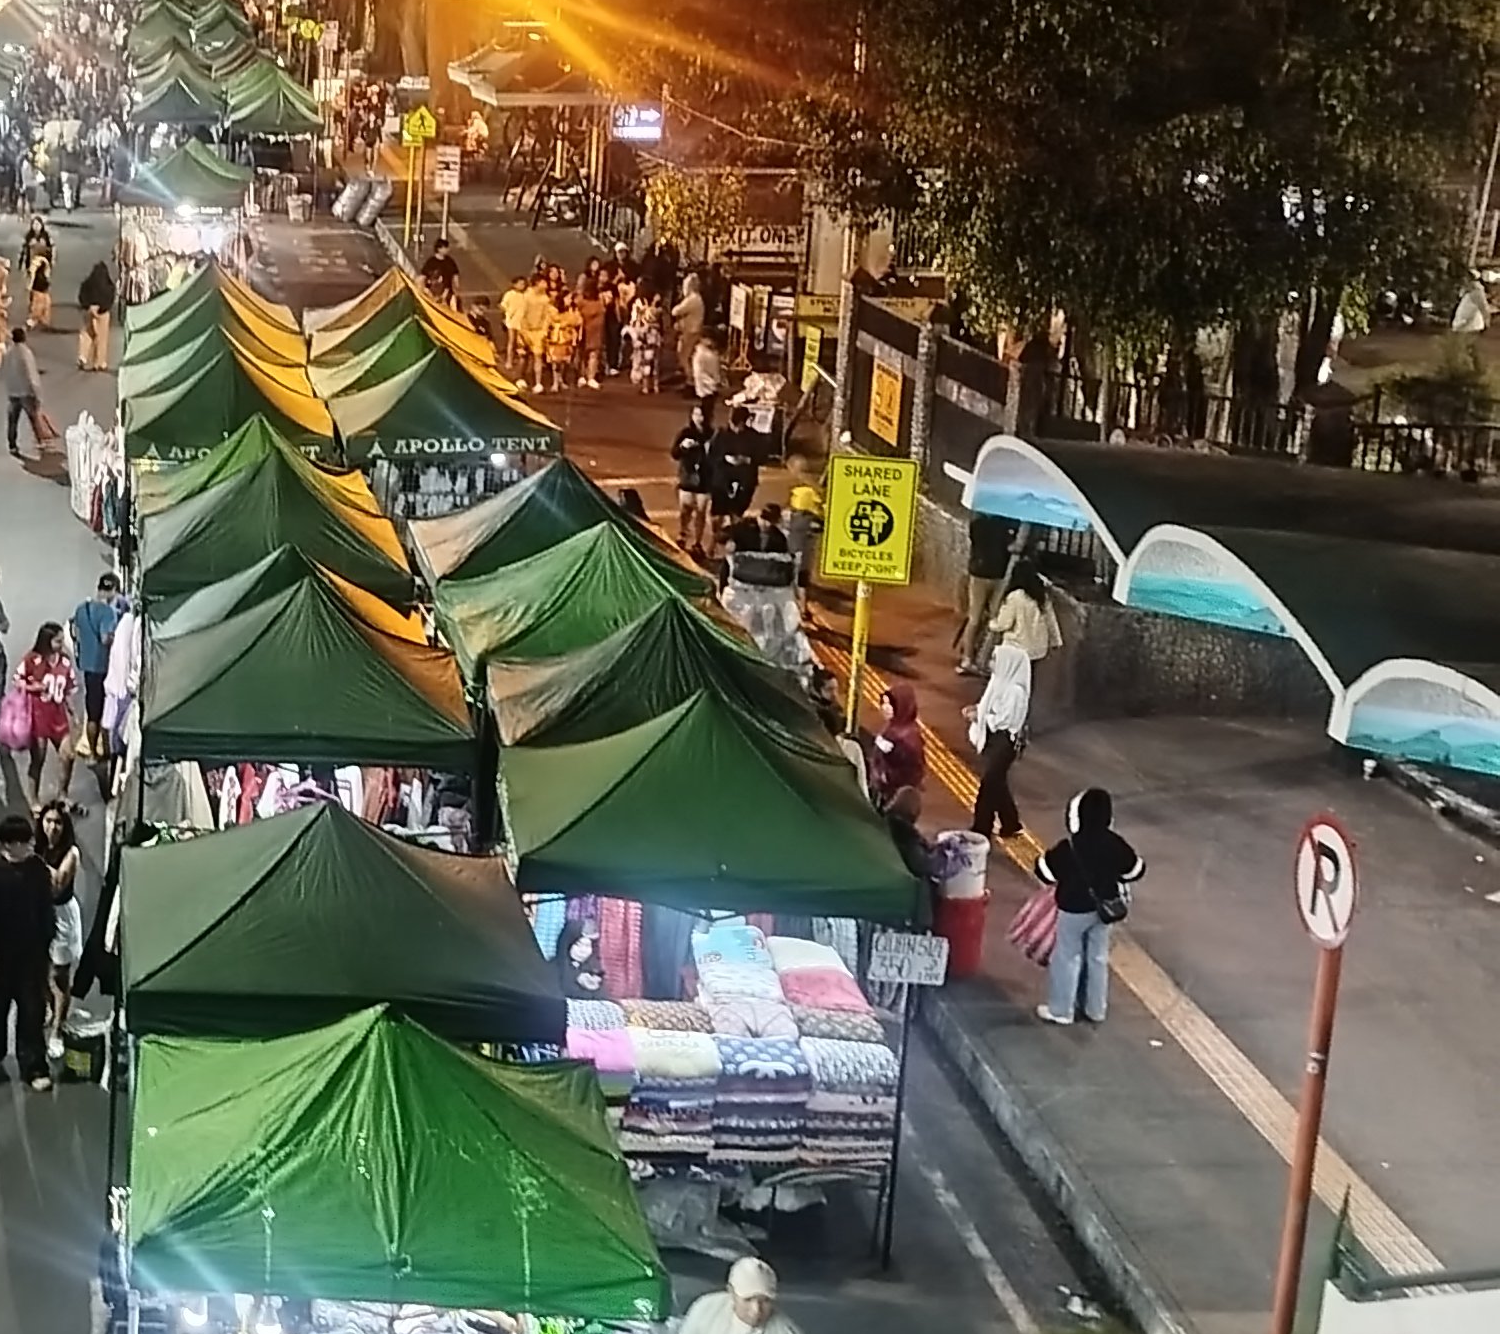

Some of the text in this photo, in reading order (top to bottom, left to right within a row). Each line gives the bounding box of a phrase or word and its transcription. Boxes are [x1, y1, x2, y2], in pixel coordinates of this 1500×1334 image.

[393, 436, 550, 454] APOLLO TENT
[844, 465, 903, 480] SHARED
[853, 482, 892, 498] LANE
[838, 547, 894, 561] BICYCLES
[832, 560, 862, 571] KEEP
